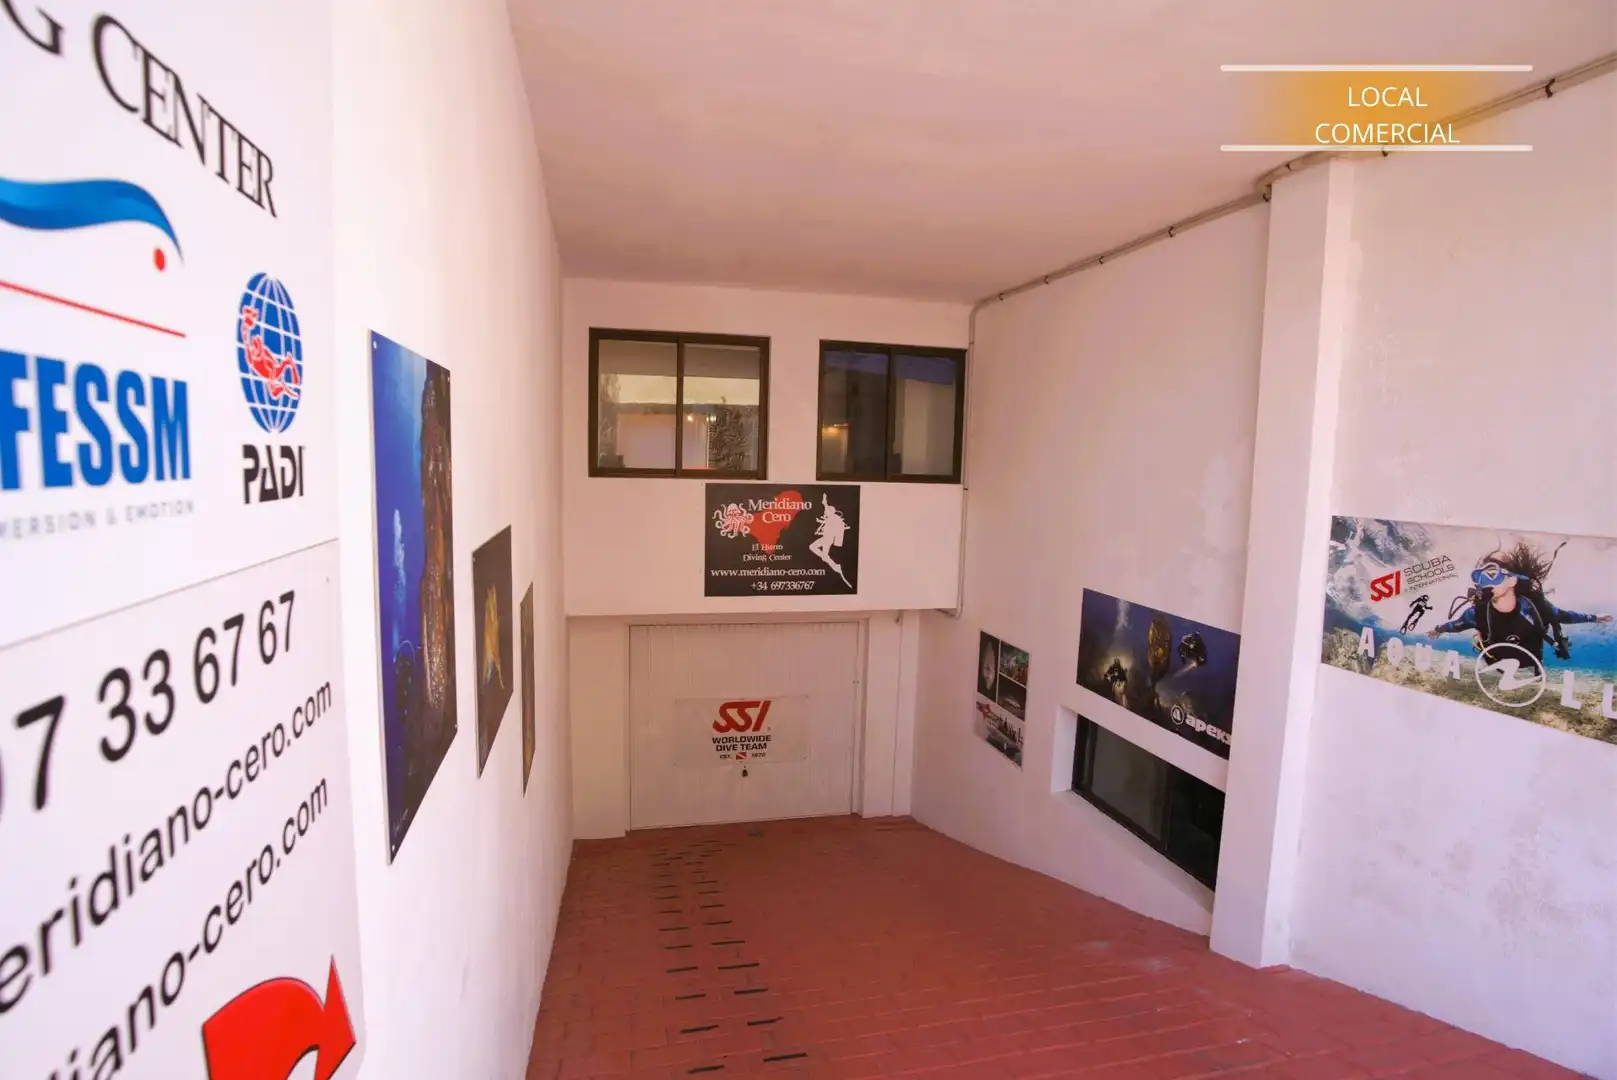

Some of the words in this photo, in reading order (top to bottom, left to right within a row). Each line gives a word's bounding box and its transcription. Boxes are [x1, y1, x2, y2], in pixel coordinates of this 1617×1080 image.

[92, 14, 277, 218] CENTER
[0, 348, 192, 491] FESSM
[242, 444, 304, 504] PADI
[125, 500, 194, 523] EMOTION
[748, 497, 813, 511] Meridiano
[762, 511, 792, 524] Cero
[742, 553, 768, 563] Diving
[768, 553, 793, 562] Center
[752, 543, 760, 552] El
[761, 543, 784, 552] Hierro
[711, 566, 826, 577] www.meridiano-cero.com
[1403, 555, 1452, 577] SCUBA
[1407, 564, 1456, 585] SCHOOLS
[750, 581, 768, 591] +34
[770, 580, 815, 590] 697336767
[1370, 570, 1401, 602] SSI
[1357, 627, 1461, 680] AQUA
[0, 694, 66, 822] 7
[98, 648, 175, 763] 33
[192, 613, 245, 704] 67
[257, 590, 295, 666] 67
[712, 700, 772, 733] SSI
[712, 735, 771, 744] WORLDWIDE
[716, 744, 738, 752] DIVE
[740, 743, 767, 751] TEAM
[0, 680, 332, 1014] eridiano-cero.com
[46, 777, 328, 1080] iano-cero.com
